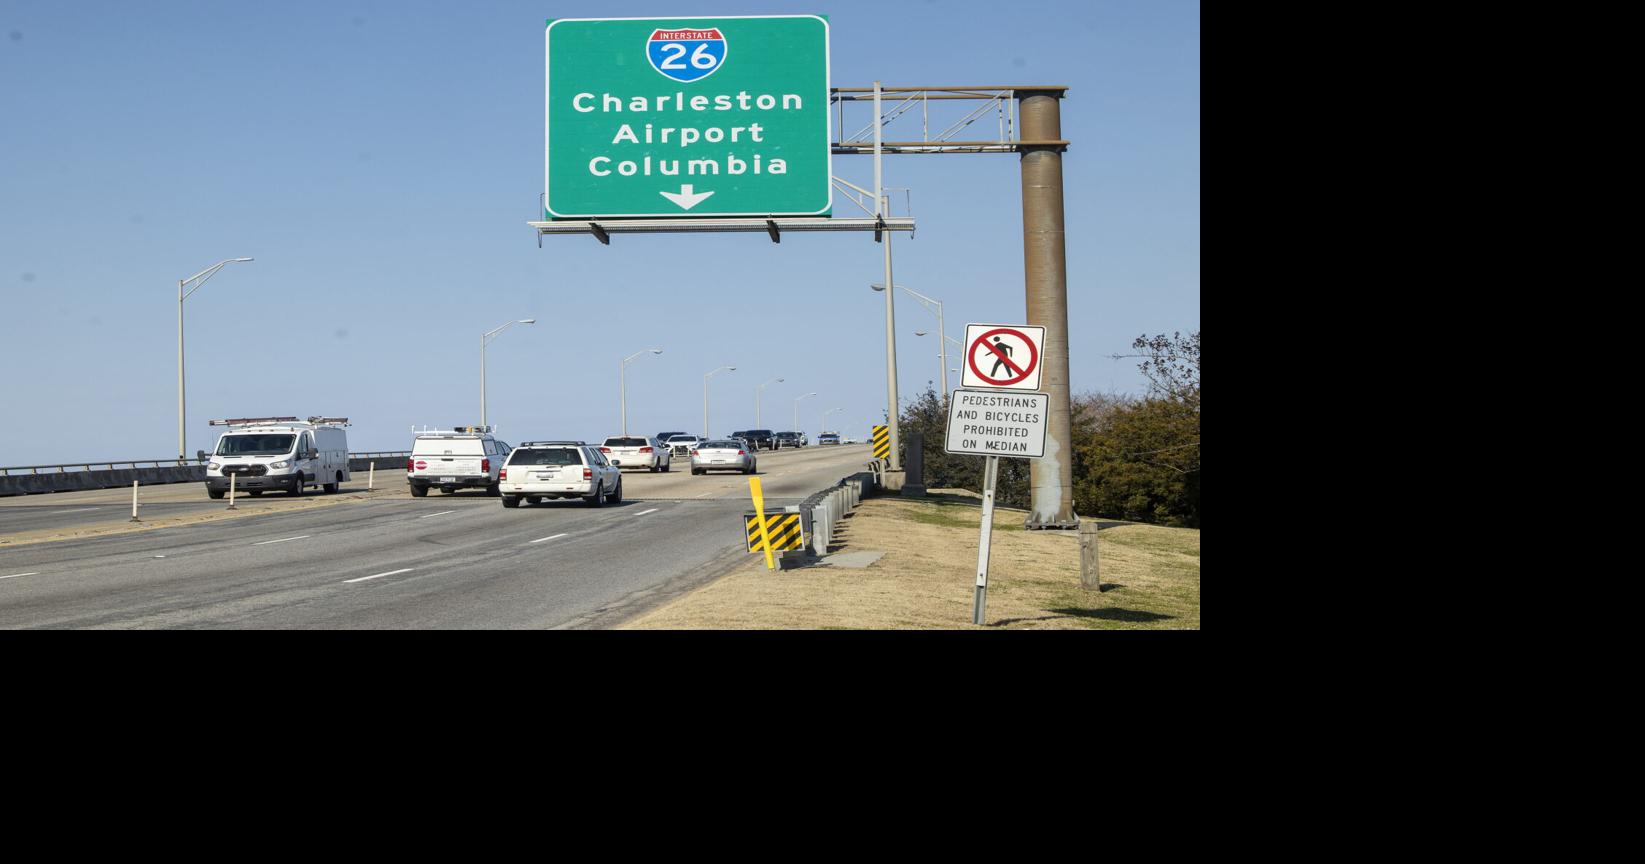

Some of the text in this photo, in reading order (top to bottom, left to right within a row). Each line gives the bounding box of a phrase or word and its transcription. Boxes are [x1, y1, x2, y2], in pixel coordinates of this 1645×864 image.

[660, 31, 713, 40] INTERSTATE
[660, 43, 717, 70] 26
[572, 91, 802, 113] Charleston
[612, 122, 764, 147] Airport
[588, 152, 787, 177] Columbia
[962, 395, 1037, 408] PEDESTRIANS
[956, 410, 1039, 423] AND BICYCLES
[963, 425, 1028, 437] PROHIBITED
[962, 439, 1027, 452] ON MEDIAN
